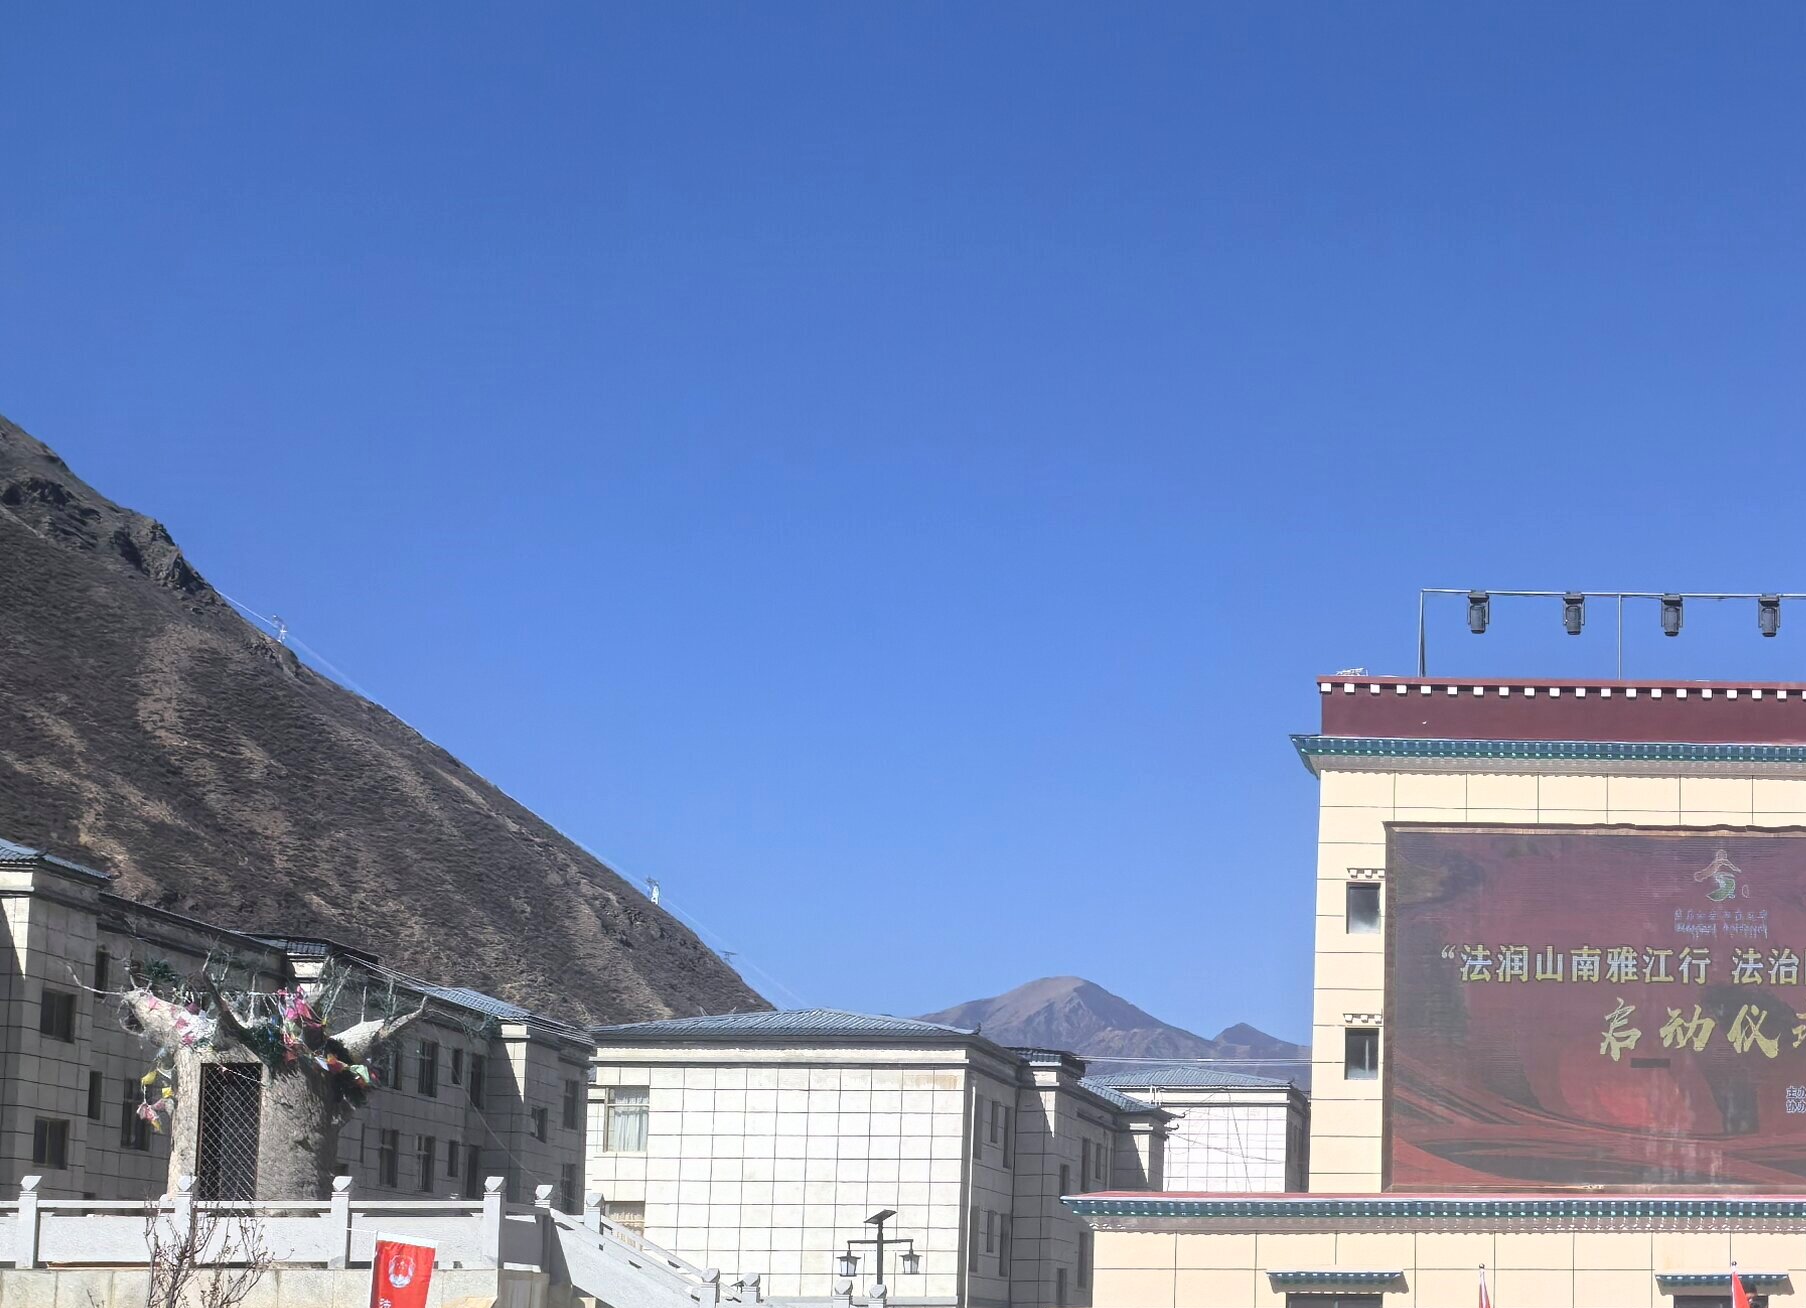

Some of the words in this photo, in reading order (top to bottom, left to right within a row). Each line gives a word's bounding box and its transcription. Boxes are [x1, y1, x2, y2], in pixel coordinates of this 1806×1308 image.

[1441, 944, 1711, 984] “法润山南雅江行
